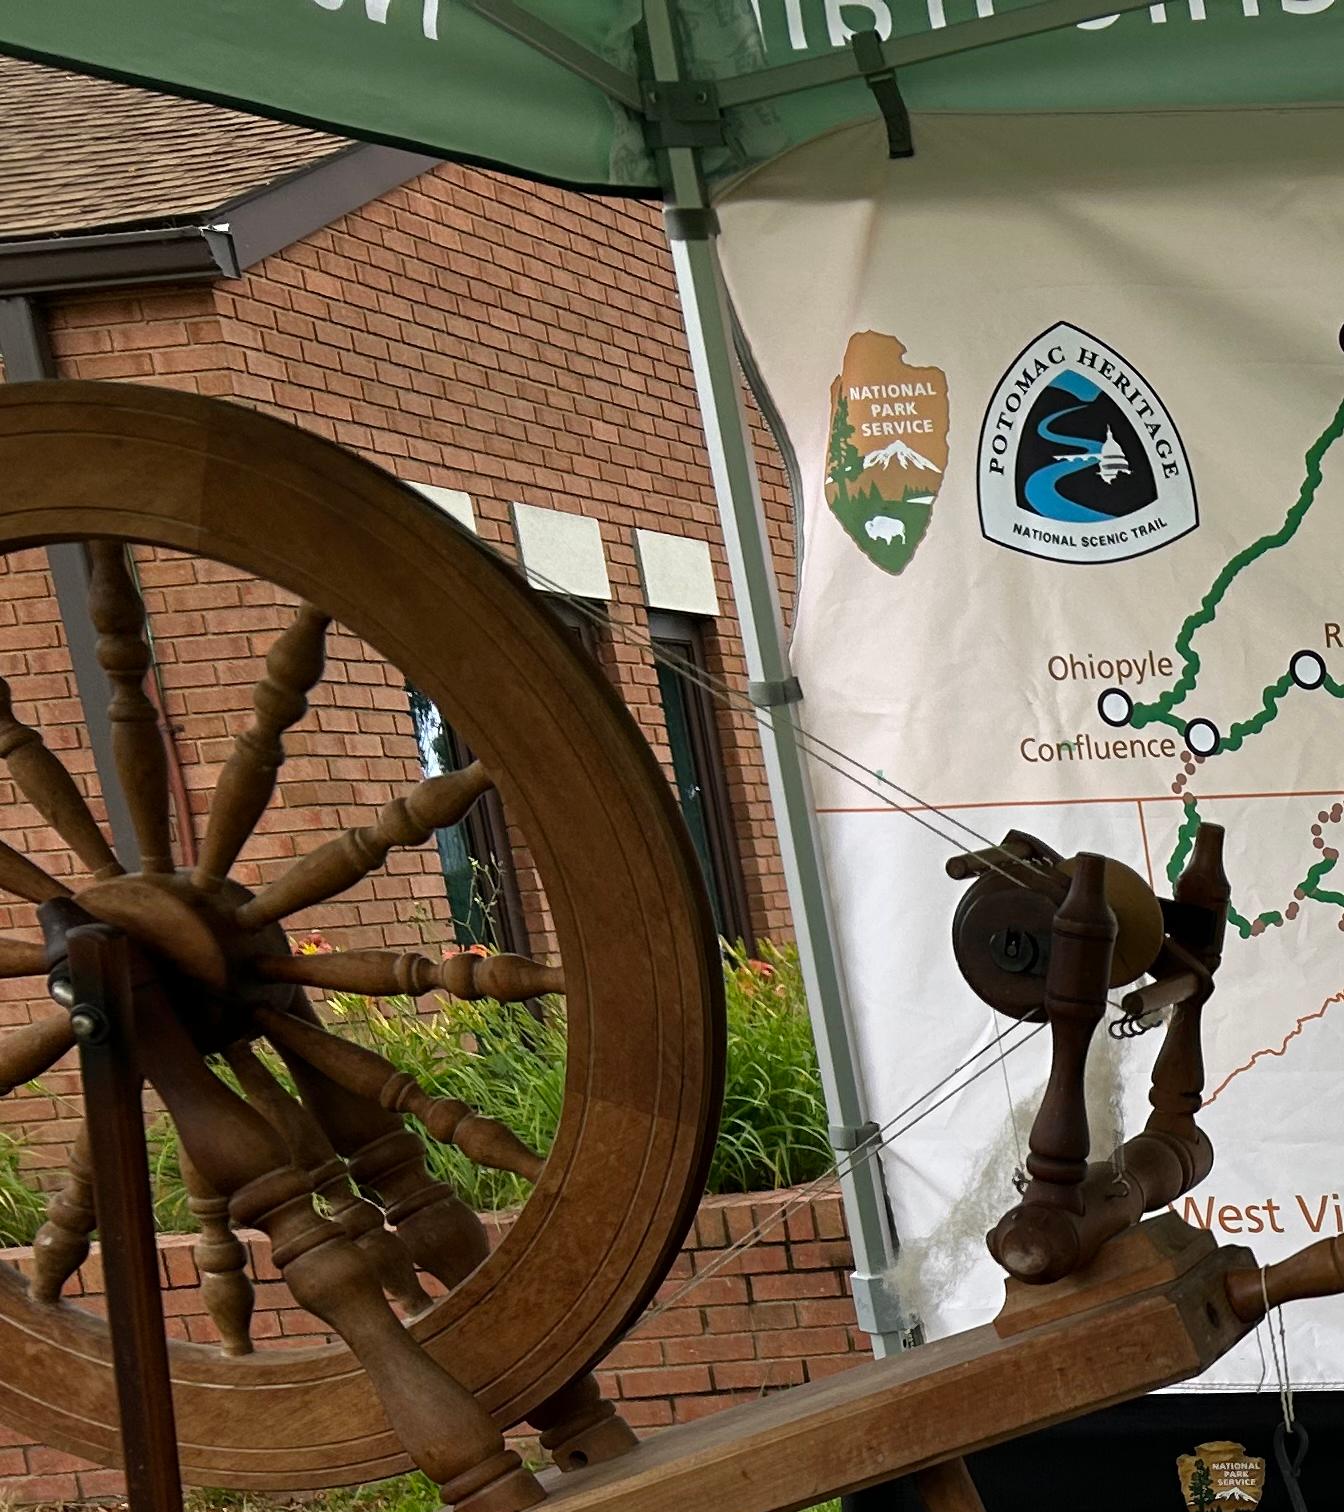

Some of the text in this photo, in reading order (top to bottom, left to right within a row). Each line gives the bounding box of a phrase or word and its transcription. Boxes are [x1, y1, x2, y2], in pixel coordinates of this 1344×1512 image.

[850, 383, 936, 400] NATIONAL
[871, 402, 917, 417] PARK
[989, 346, 1180, 479] POTOMAC HERITAGE
[862, 420, 933, 436] SERVICE
[1013, 518, 1168, 547] NATIONAL SCENIC TRAIL
[1048, 650, 1172, 685] Ohiopyle
[1021, 734, 1175, 762] Confluence
[1168, 1196, 1284, 1233] West
[1212, 1462, 1260, 1471] NATIONAL
[1224, 1470, 1249, 1478] PARK
[1218, 1478, 1256, 1486] SERVICE
